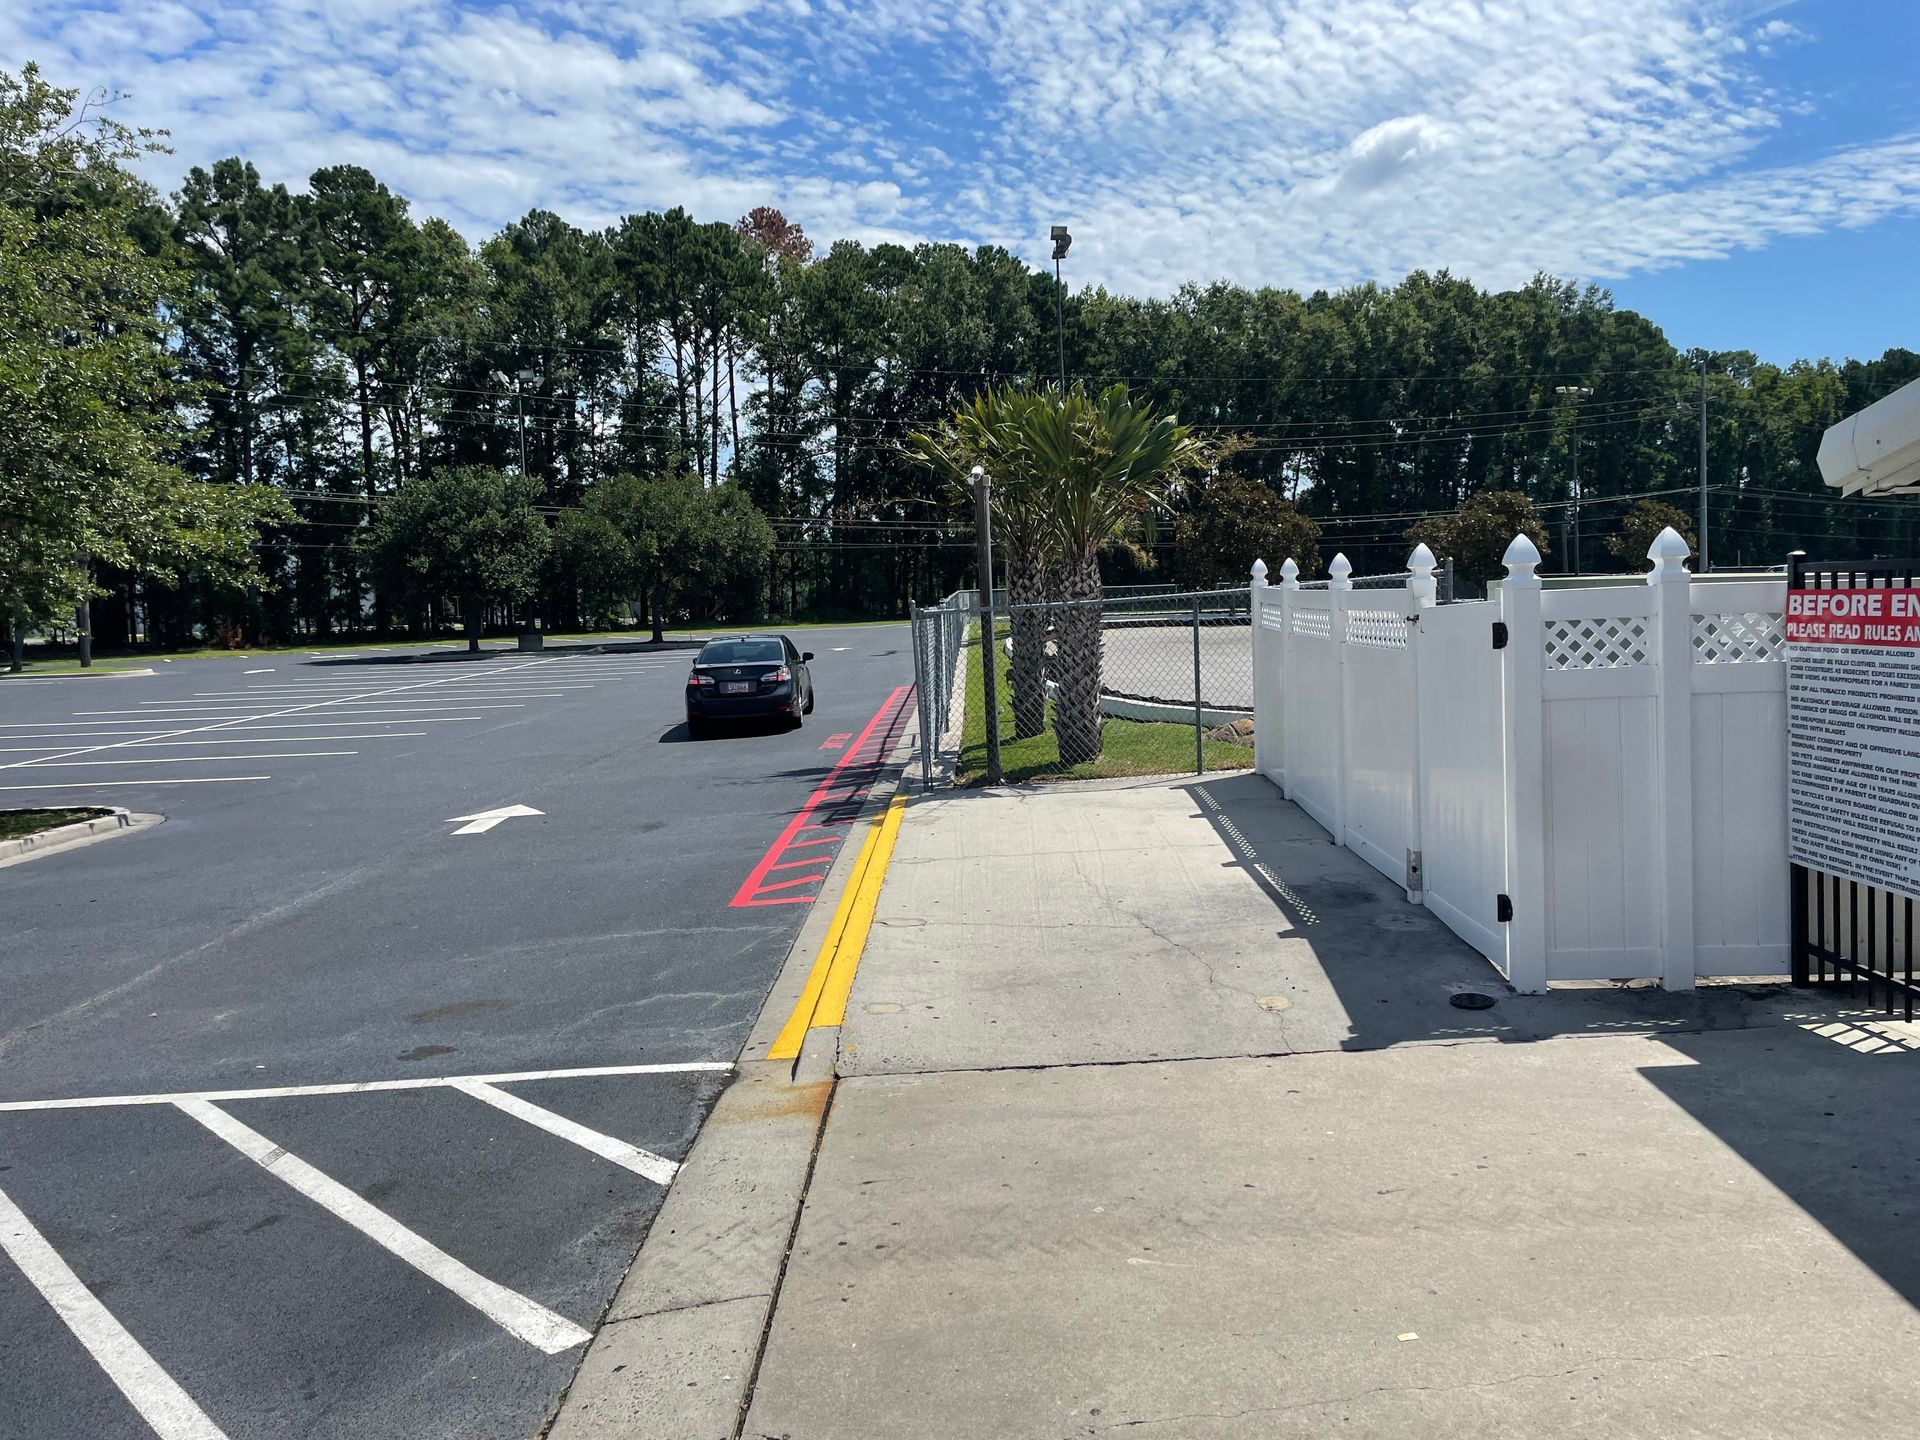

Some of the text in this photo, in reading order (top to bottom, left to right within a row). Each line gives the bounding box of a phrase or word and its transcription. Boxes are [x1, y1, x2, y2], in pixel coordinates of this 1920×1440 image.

[1788, 594, 1882, 616] BEFORE
[1787, 623, 1825, 638] PLEASE
[1829, 624, 1860, 639] READ
[1864, 624, 1901, 641] RULES
[1800, 696, 1830, 705] ALCOHOLIC
[1848, 690, 1878, 698] PRODUCTS
[1880, 693, 1915, 702] PROHIBITED
[1800, 715, 1826, 724] WEAPONS
[1827, 719, 1854, 728] ALLOWED
[1867, 724, 1896, 733] PROPERTY
[1859, 712, 1886, 720] ALCOHOL
[1825, 727, 1845, 735] BLADES
[1817, 736, 1844, 746] CONDUCT
[1870, 745, 1901, 755] OFFENSIVE
[1834, 748, 1862, 757] PROPERTY
[1814, 755, 1840, 764] ALLOWED
[1841, 759, 1873, 770] ANYWHERE
[1792, 759, 1811, 767] SERVICE
[1813, 763, 1836, 772] ANIMALS
[1851, 770, 1879, 780] ALLOWED
[1902, 779, 1917, 788] PARK
[1792, 777, 1829, 790] ACCOMPANIED
[1845, 788, 1867, 798] PARENT
[1878, 795, 1910, 807] GUARDIAN
[1814, 774, 1833, 782] UNDER
[1878, 786, 1895, 795] YEARS
[1801, 790, 1824, 800] BICYCLES
[1835, 797, 1852, 806] SKATE
[1853, 801, 1877, 812] BOARDS
[1878, 807, 1907, 818] ALLOWED
[1792, 798, 1820, 810] VIOLATION
[1830, 807, 1850, 817] SAFETY
[1851, 812, 1868, 821] RULES
[1880, 818, 1905, 830] REFUSAL
[1804, 820, 1841, 834] DESTRUCTION
[1851, 832, 1880, 844] PROPERTY
[1882, 840, 1896, 848] WILL
[1897, 843, 1918, 854] RESULT
[1826, 815, 1842, 823] STAFF
[1843, 819, 1856, 827] WILL
[1858, 822, 1878, 832] RESULT
[1887, 829, 1916, 841] REMOVAL
[1841, 839, 1854, 848] RISK
[1855, 843, 1874, 853] WHILE
[1875, 848, 1893, 859] USING
[1894, 853, 1907, 862] ANY
[1869, 856, 1885, 865] OWN
[1851, 870, 1865, 879] WITH
[1865, 874, 1883, 885] TIMED
[1863, 865, 1874, 873] THE
[1875, 868, 1893, 879] EVENT
[1895, 874, 1909, 884] THAT
